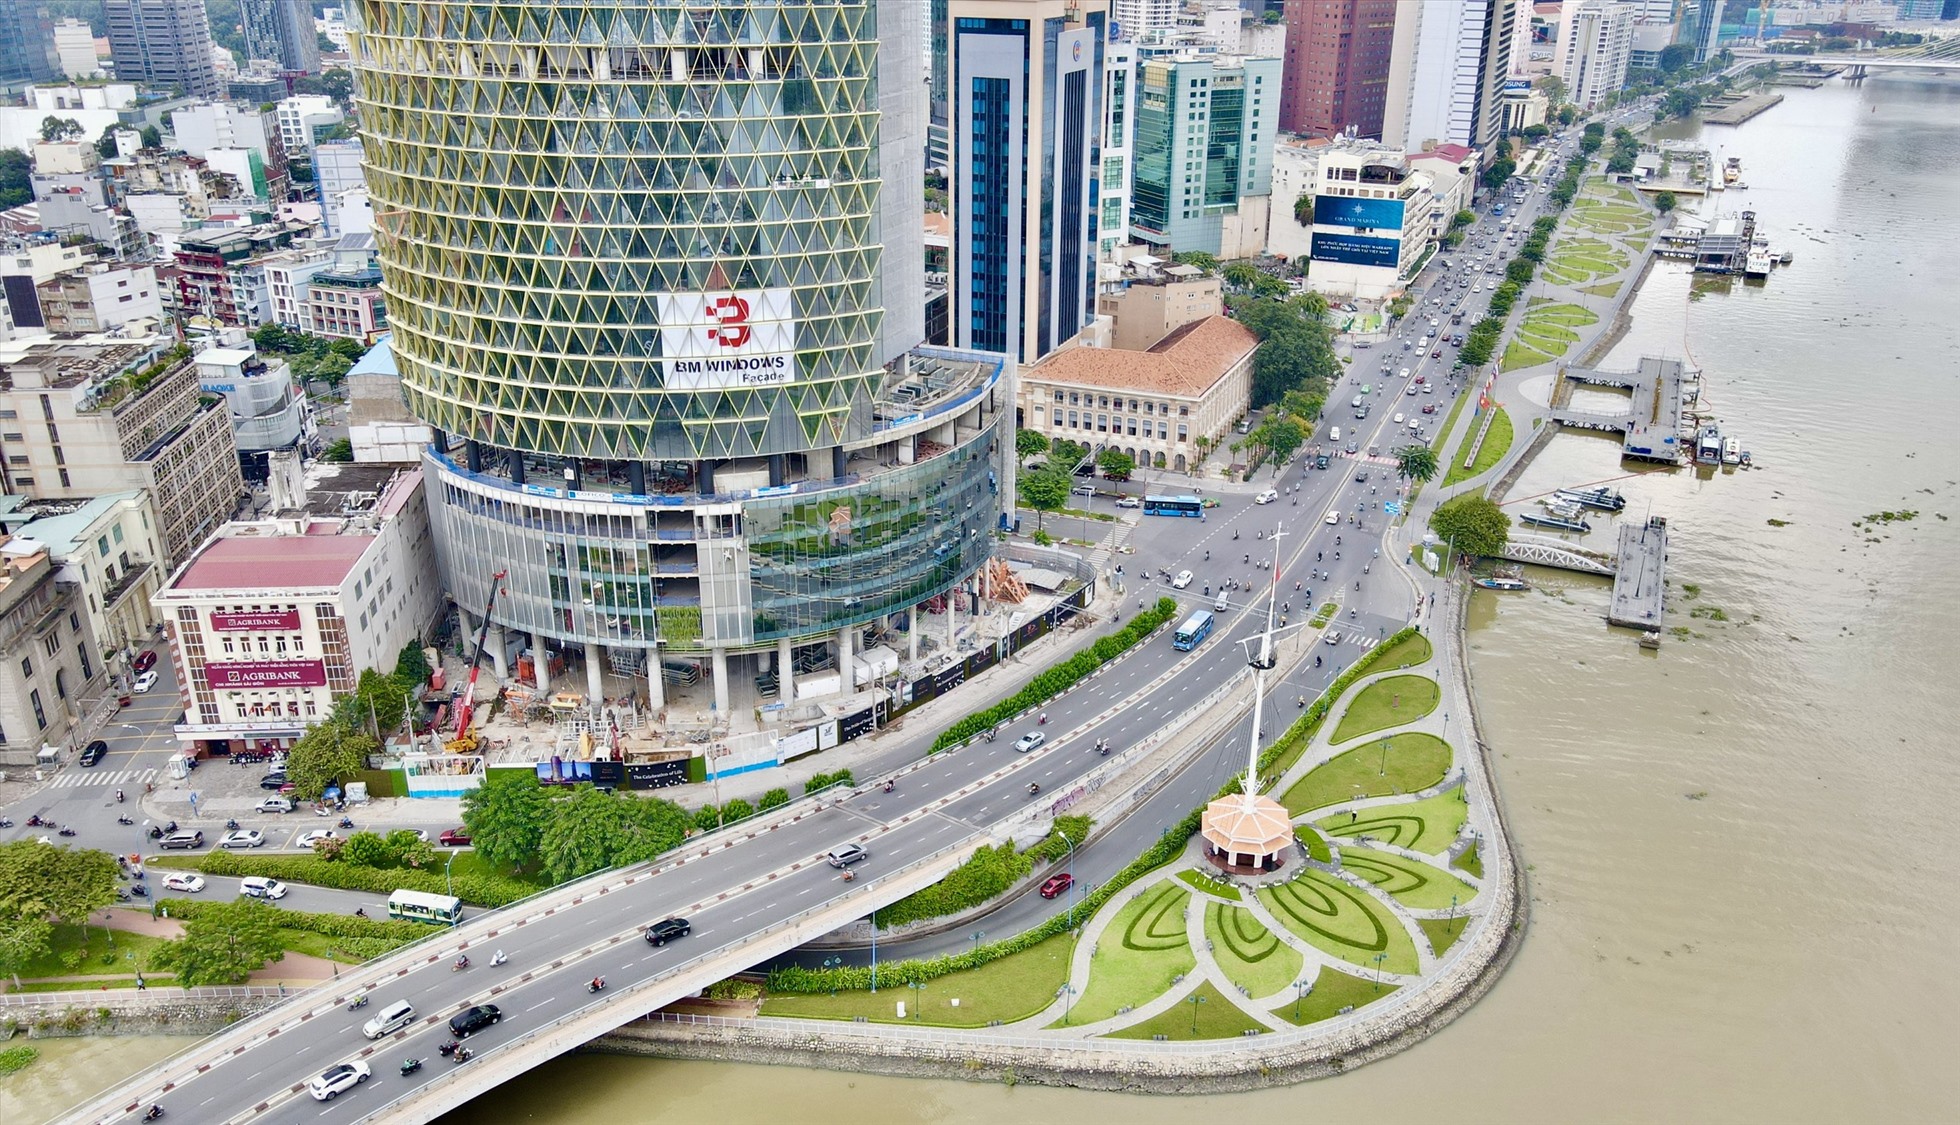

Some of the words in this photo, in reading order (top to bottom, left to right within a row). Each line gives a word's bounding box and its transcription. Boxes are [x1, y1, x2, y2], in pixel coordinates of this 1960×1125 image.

[675, 360, 701, 373] BM
[706, 356, 784, 372] WINDOWS
[743, 373, 784, 384] Façade
[242, 671, 301, 681] AGRIBANK
